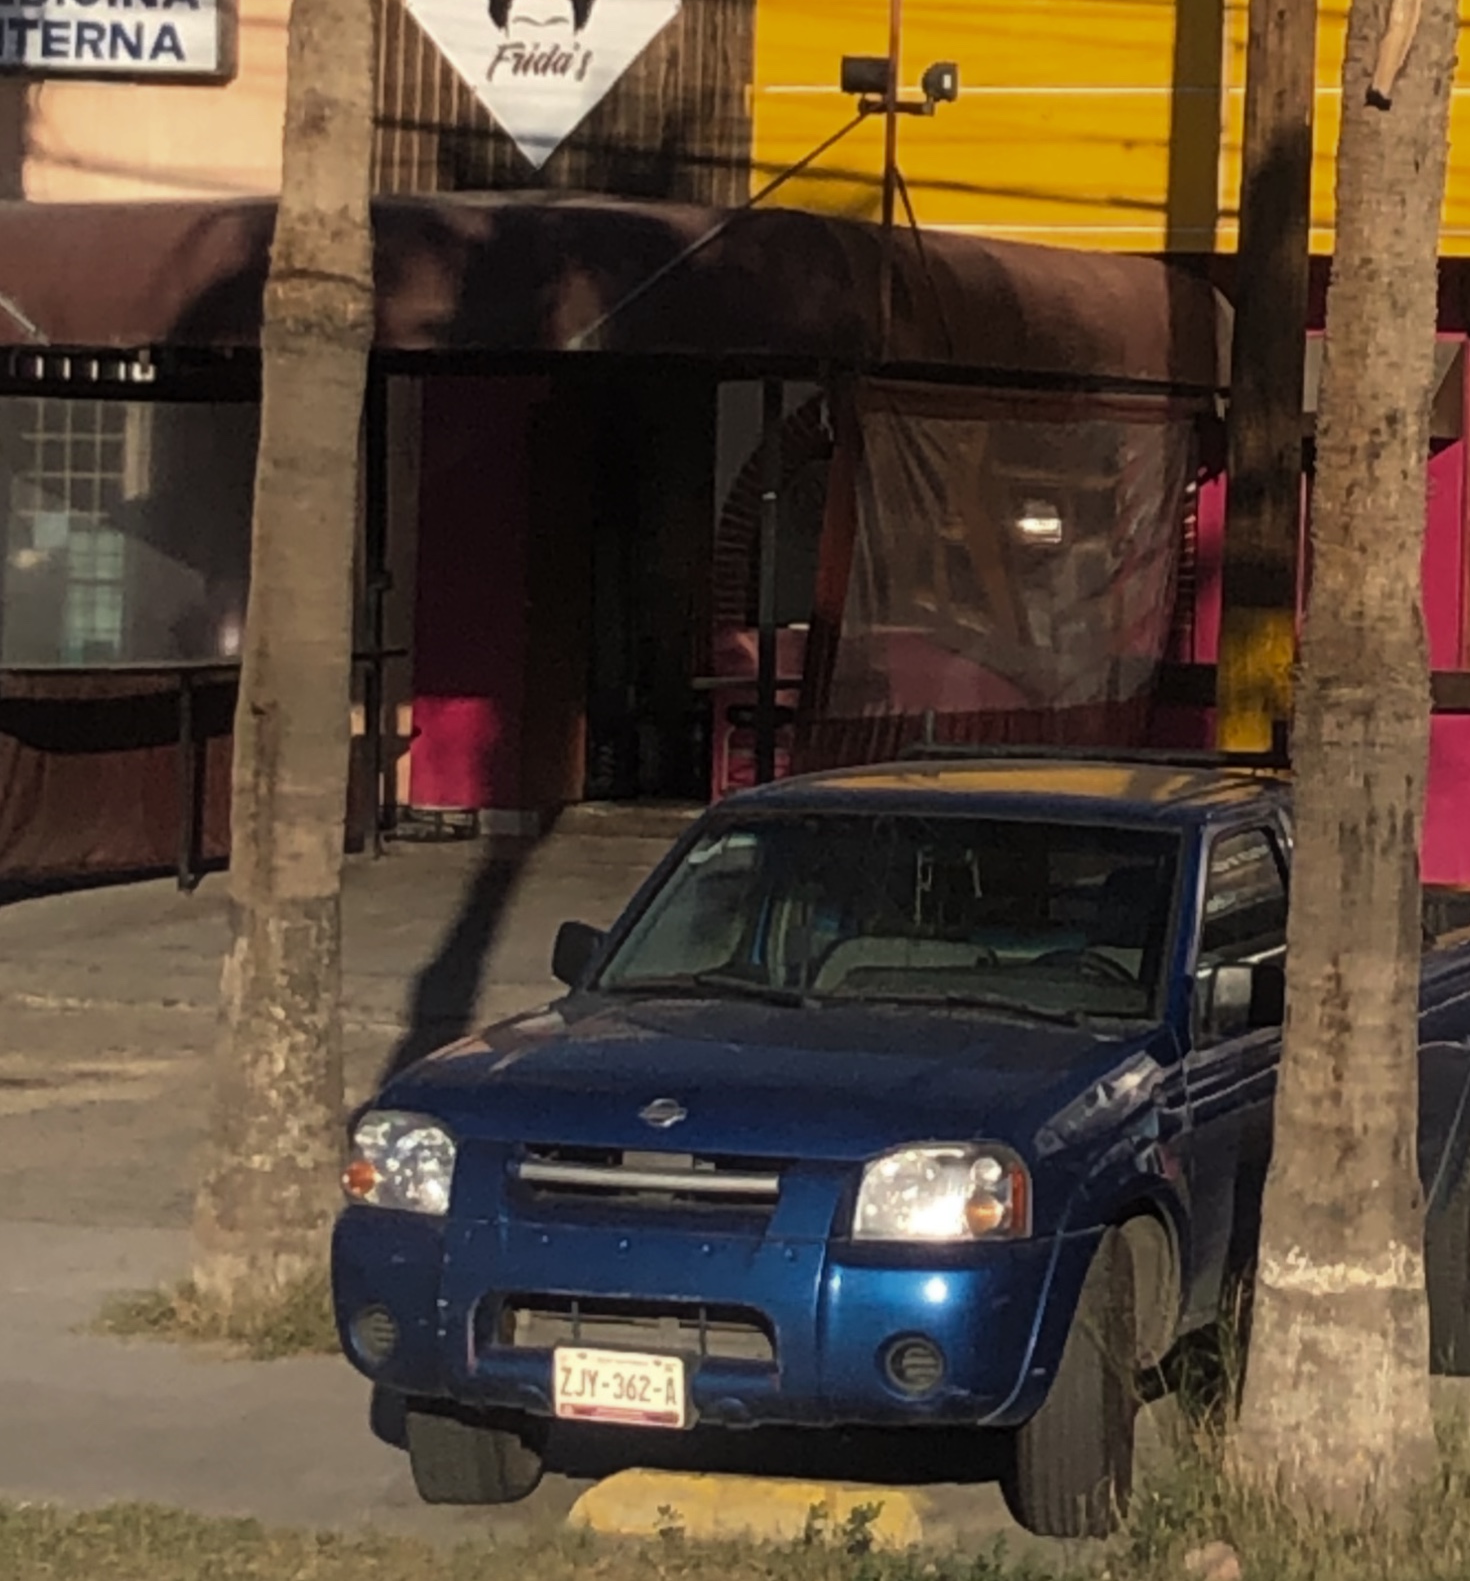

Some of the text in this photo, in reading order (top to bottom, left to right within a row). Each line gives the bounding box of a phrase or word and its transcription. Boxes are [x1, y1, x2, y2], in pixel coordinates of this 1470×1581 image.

[0, 19, 187, 63] TERNA
[486, 40, 593, 82] Frida's
[560, 1367, 677, 1406] ZJY-362-A
